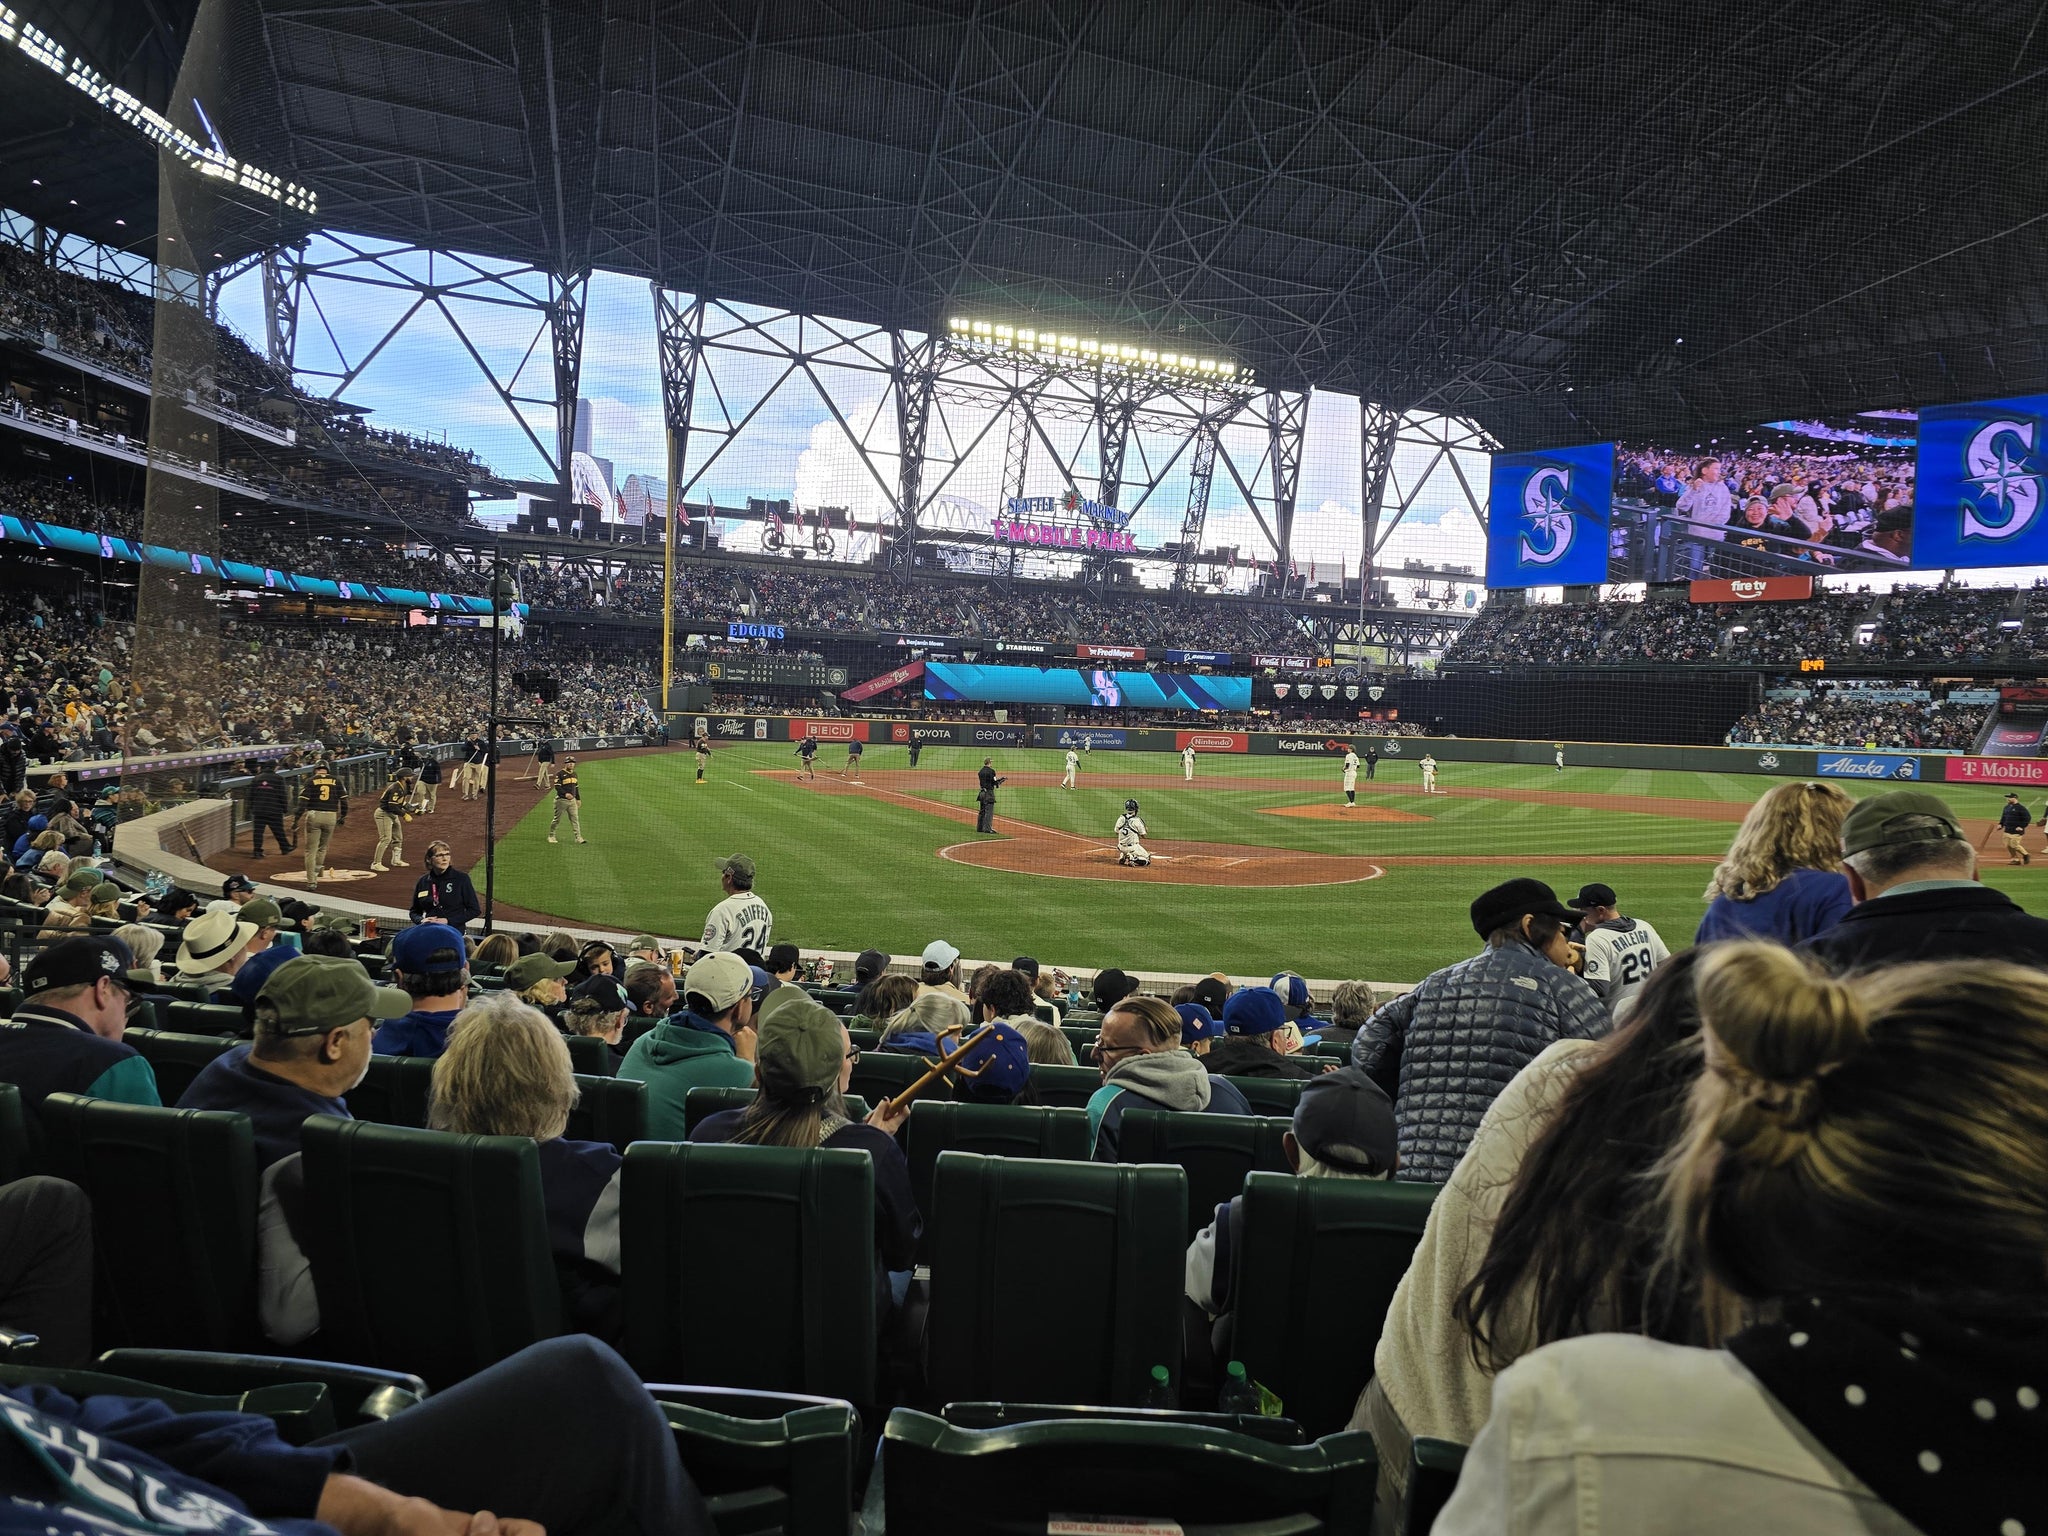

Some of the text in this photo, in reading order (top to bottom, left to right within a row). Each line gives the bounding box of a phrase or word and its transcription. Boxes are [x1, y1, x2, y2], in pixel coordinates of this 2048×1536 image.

[1008, 496, 1130, 527] SEATTLE MARINERS
[991, 519, 1138, 553] T-MOBILE PARK
[1731, 581, 1766, 592] fire tv
[729, 624, 784, 639] EDGARS
[1006, 644, 1044, 652] STARBUCKS
[717, 722, 746, 734] Miller
[913, 729, 951, 738] TOYOTA
[976, 730, 1004, 740] eero
[1194, 738, 1230, 746] Nintendo
[1279, 740, 1324, 751] KeyBank
[1822, 758, 1885, 777] Alaska
[1982, 762, 2043, 778] Mobile
[320, 785, 330, 800] 3
[446, 883, 453, 893] S
[741, 924, 766, 955] 24
[1611, 930, 1649, 952] RALEIGH
[1621, 948, 1653, 985] 29
